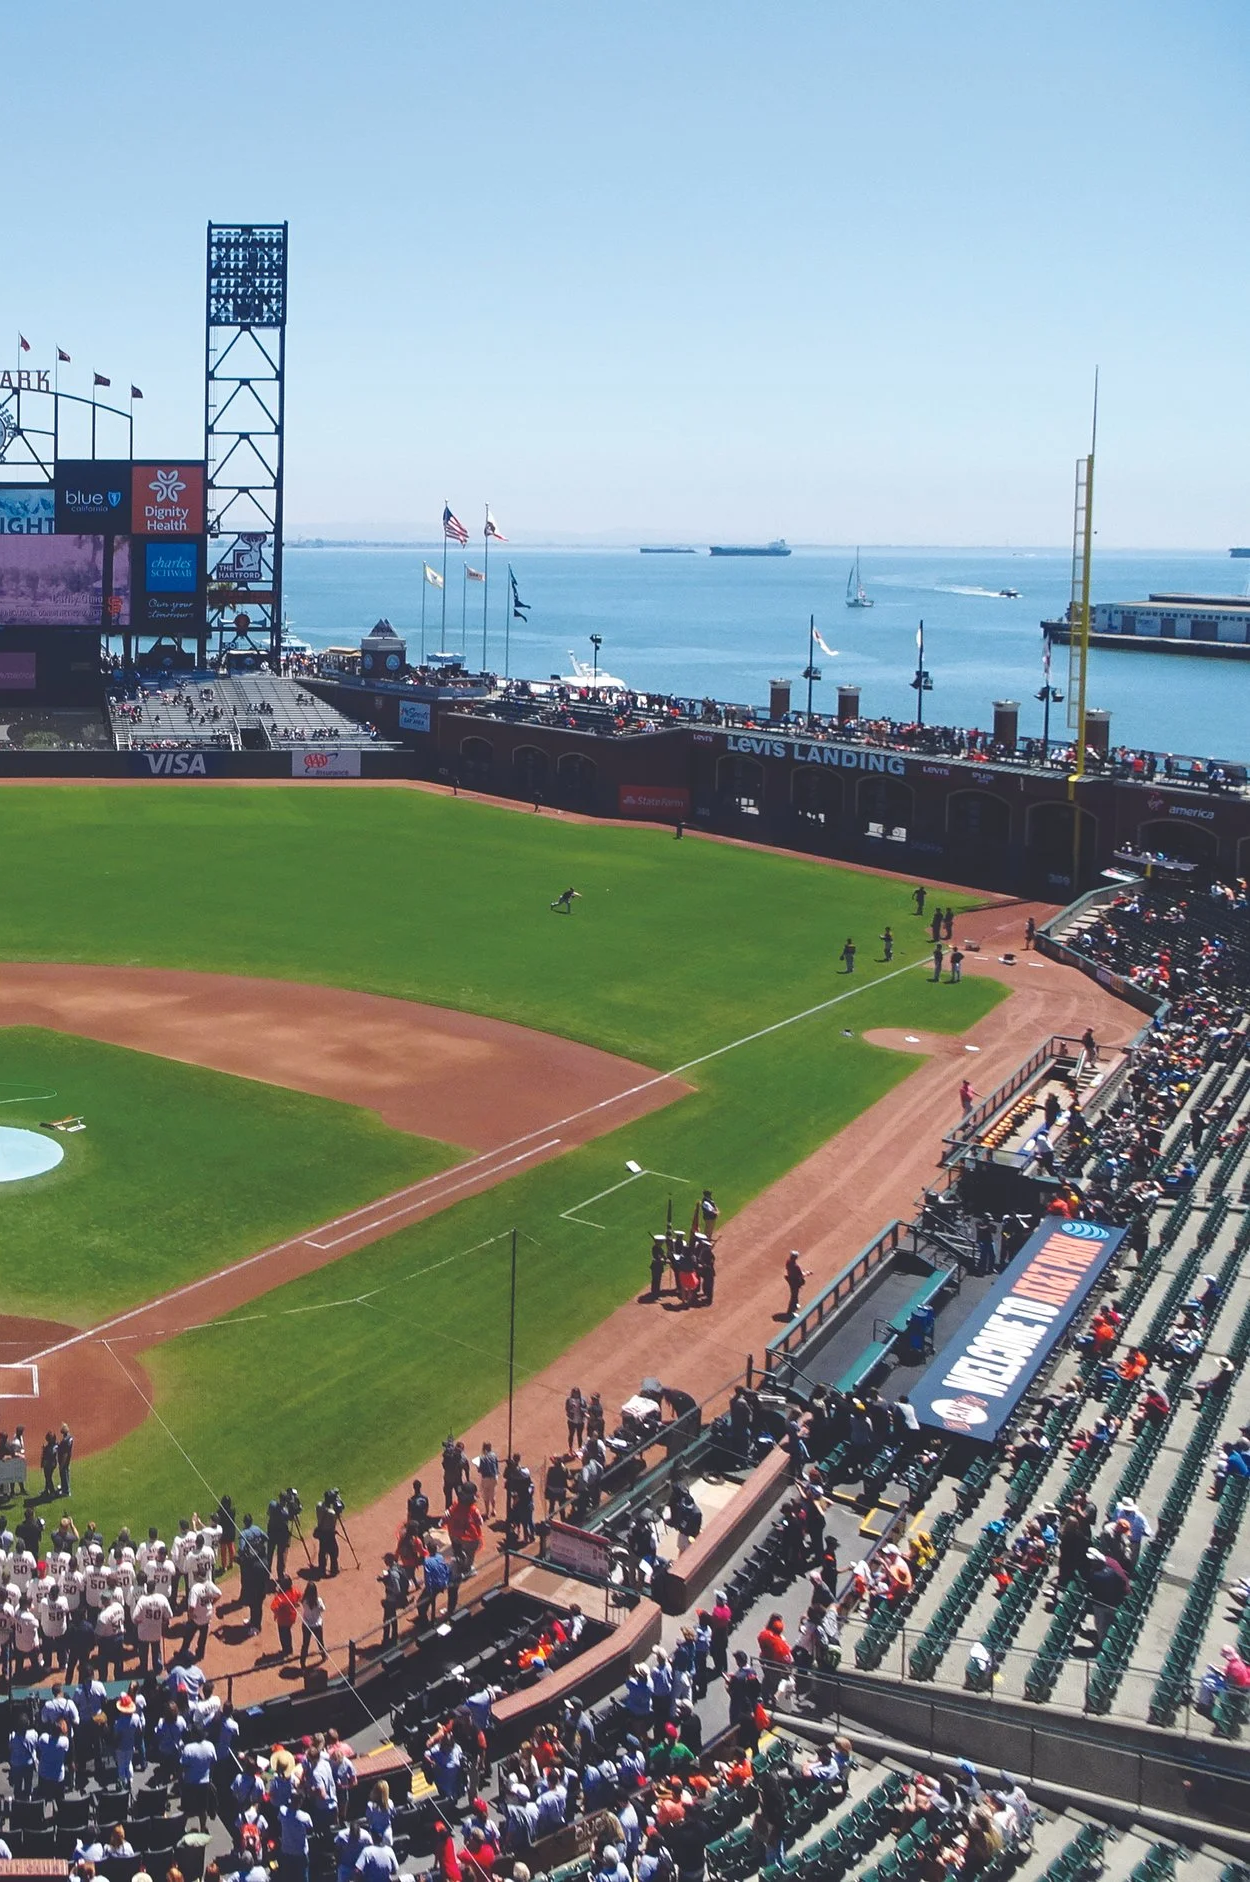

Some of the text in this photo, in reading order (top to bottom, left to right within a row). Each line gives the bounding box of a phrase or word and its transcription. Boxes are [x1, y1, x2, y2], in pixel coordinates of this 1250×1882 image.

[65, 490, 103, 505] blue
[144, 506, 189, 519] Dignity
[147, 519, 187, 531] Health
[151, 556, 192, 568] charles
[150, 569, 192, 578] SCHWAB
[143, 753, 207, 774] VISA
[304, 753, 328, 768] AAA
[793, 741, 906, 776] LANDING
[315, 768, 350, 776] Insurance
[1169, 804, 1215, 820] america
[942, 1232, 1104, 1398] WELCOME TO AT&T PARK
[13, 1564, 28, 1575] 50
[90, 1579, 106, 1590] 50
[153, 1574, 169, 1584] 50
[63, 1584, 78, 1595] 50
[48, 1610, 64, 1622] 50
[146, 1609, 162, 1621] 50
[574, 1817, 605, 1841] blue
